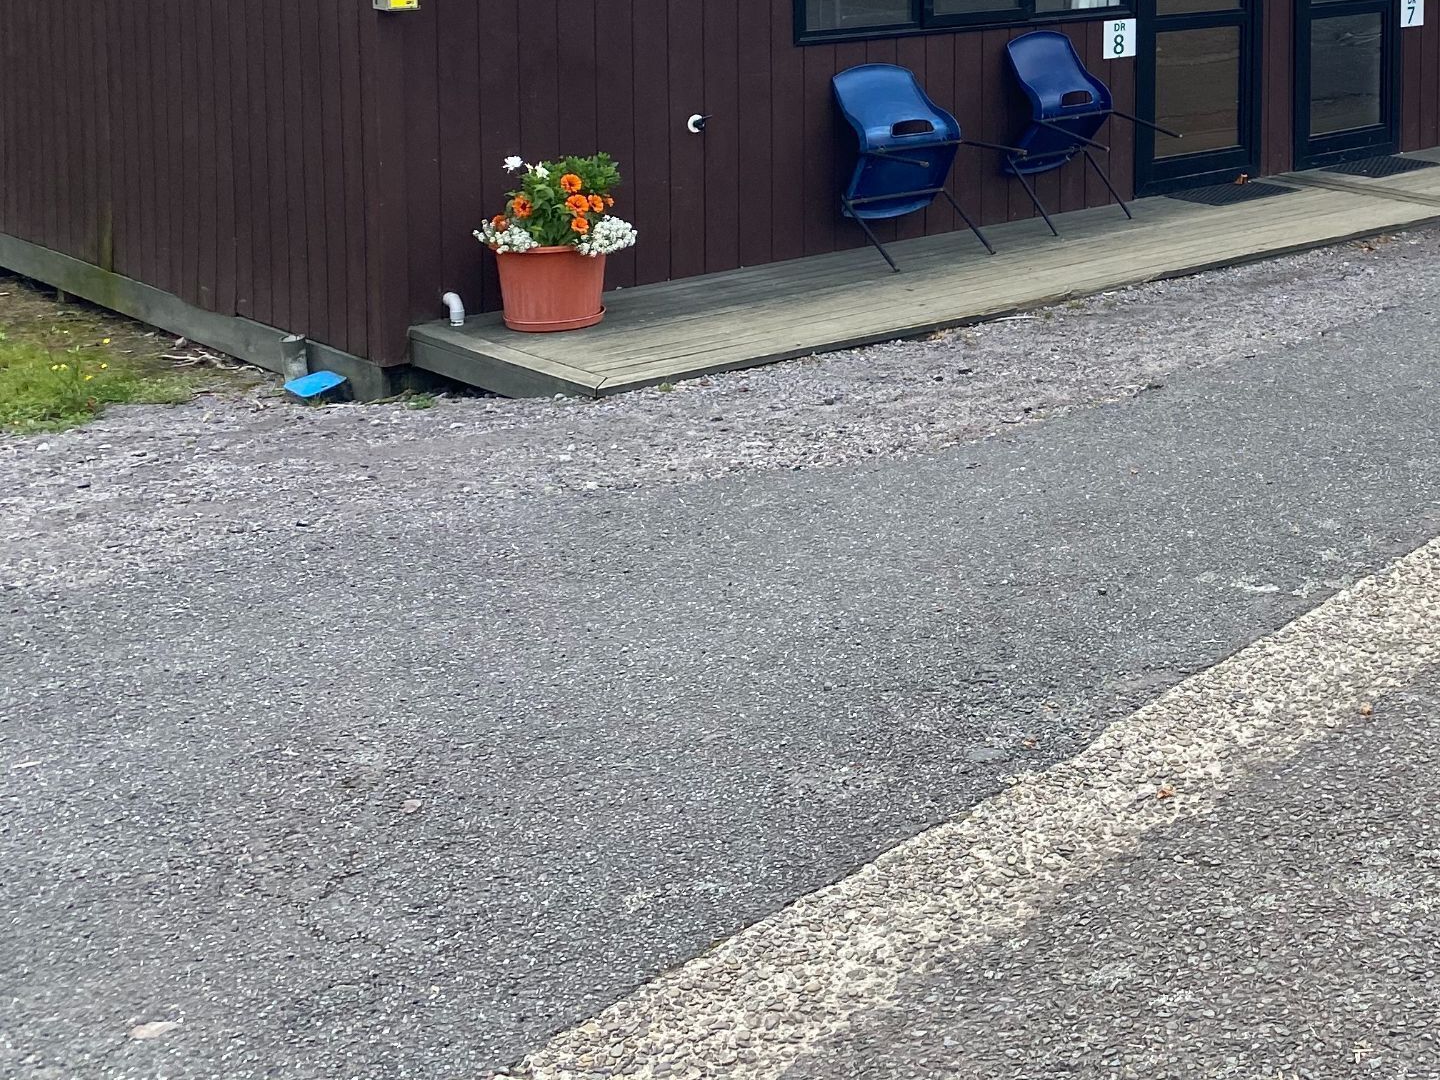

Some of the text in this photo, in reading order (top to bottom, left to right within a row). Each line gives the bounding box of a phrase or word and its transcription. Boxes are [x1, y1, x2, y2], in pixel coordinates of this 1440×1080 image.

[1407, 6, 1415, 24] 7
[1114, 23, 1126, 31] DR
[1113, 34, 1124, 54] 8
